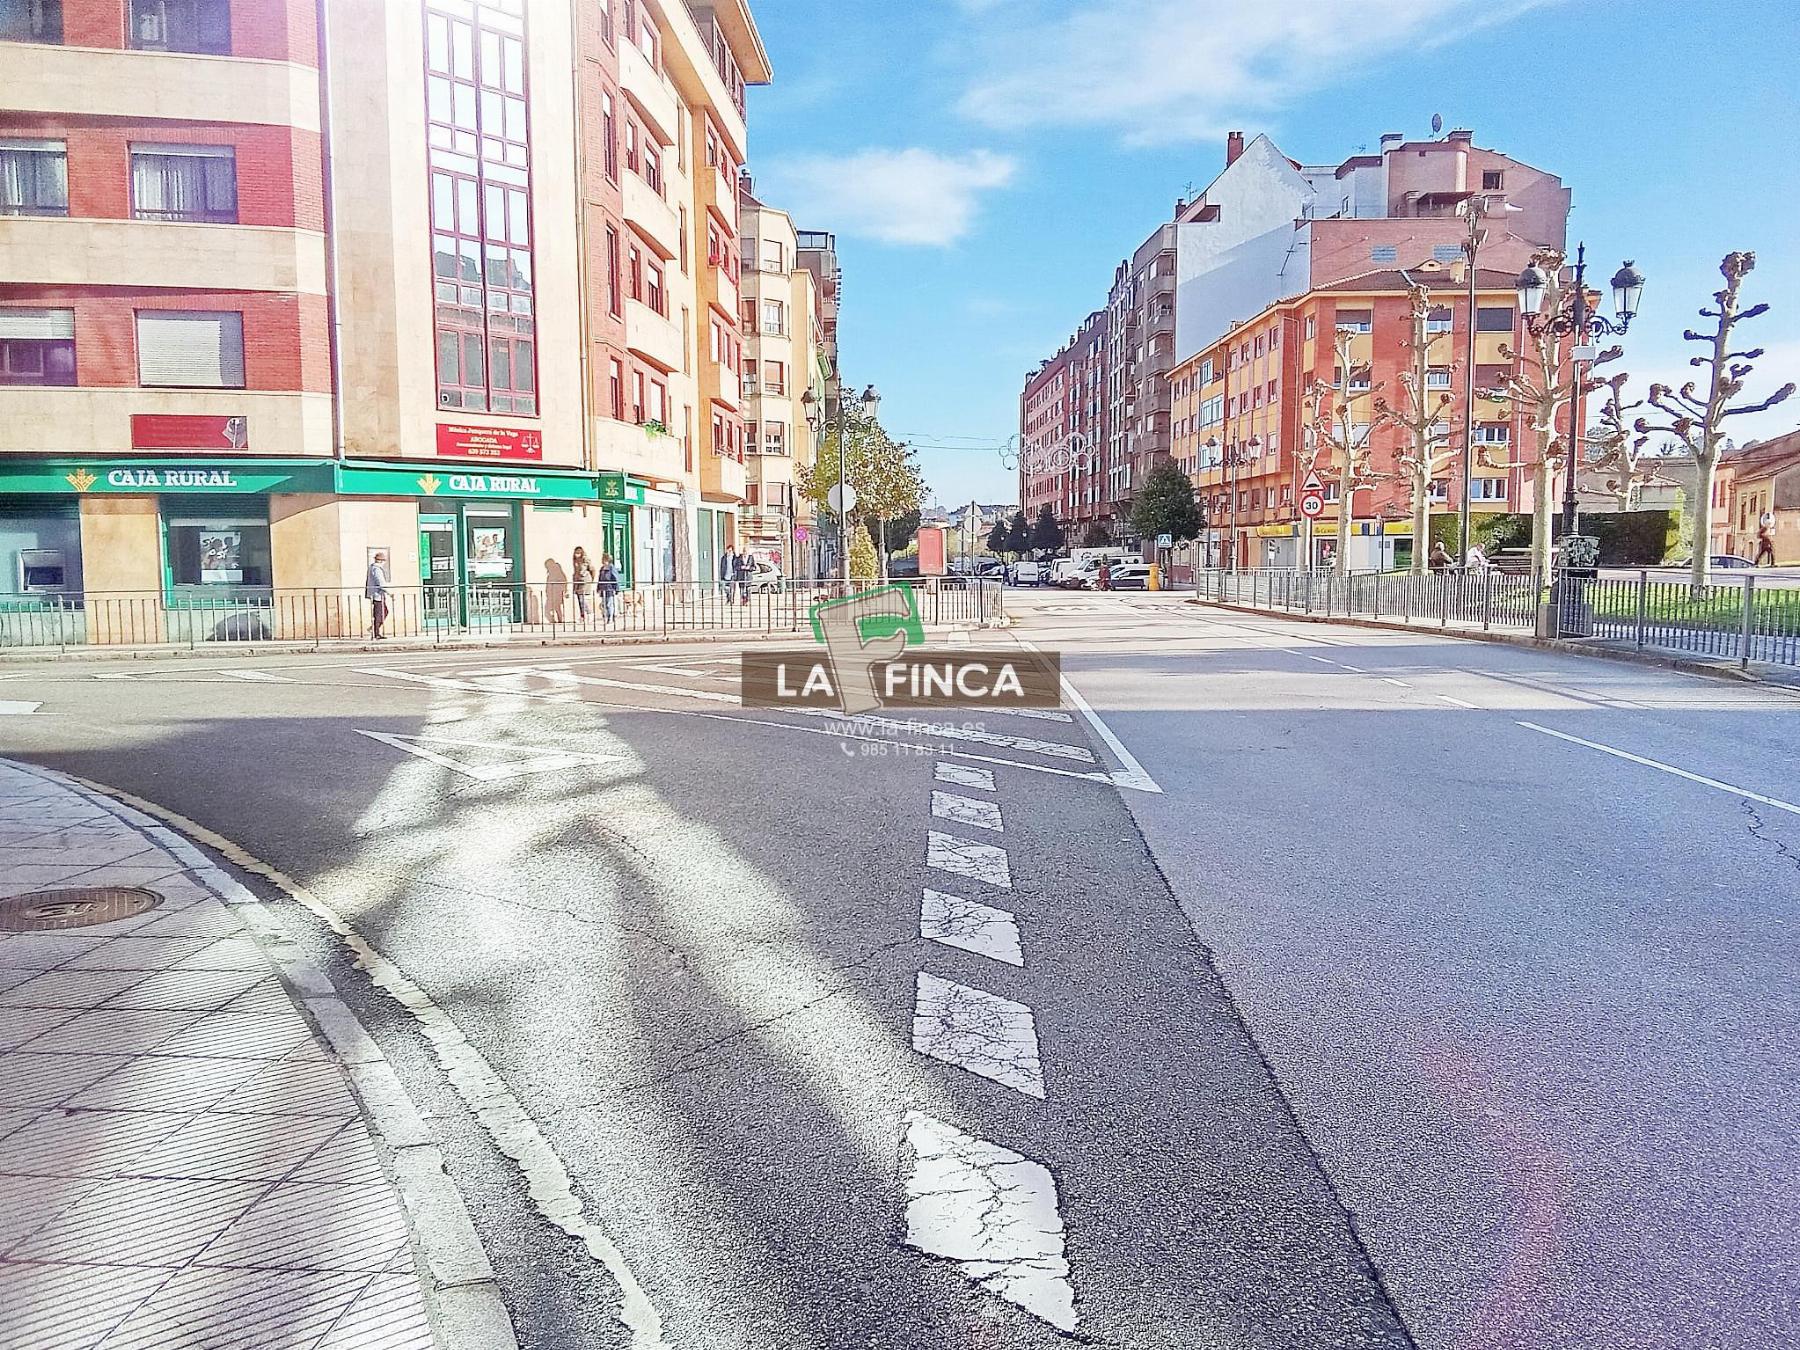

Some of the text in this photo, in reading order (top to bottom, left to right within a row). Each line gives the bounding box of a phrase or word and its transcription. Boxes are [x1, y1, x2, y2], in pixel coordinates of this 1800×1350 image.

[107, 469, 237, 487] CAJA RURAL
[448, 475, 540, 493] CAJA RURAL
[1305, 501, 1318, 509] 30
